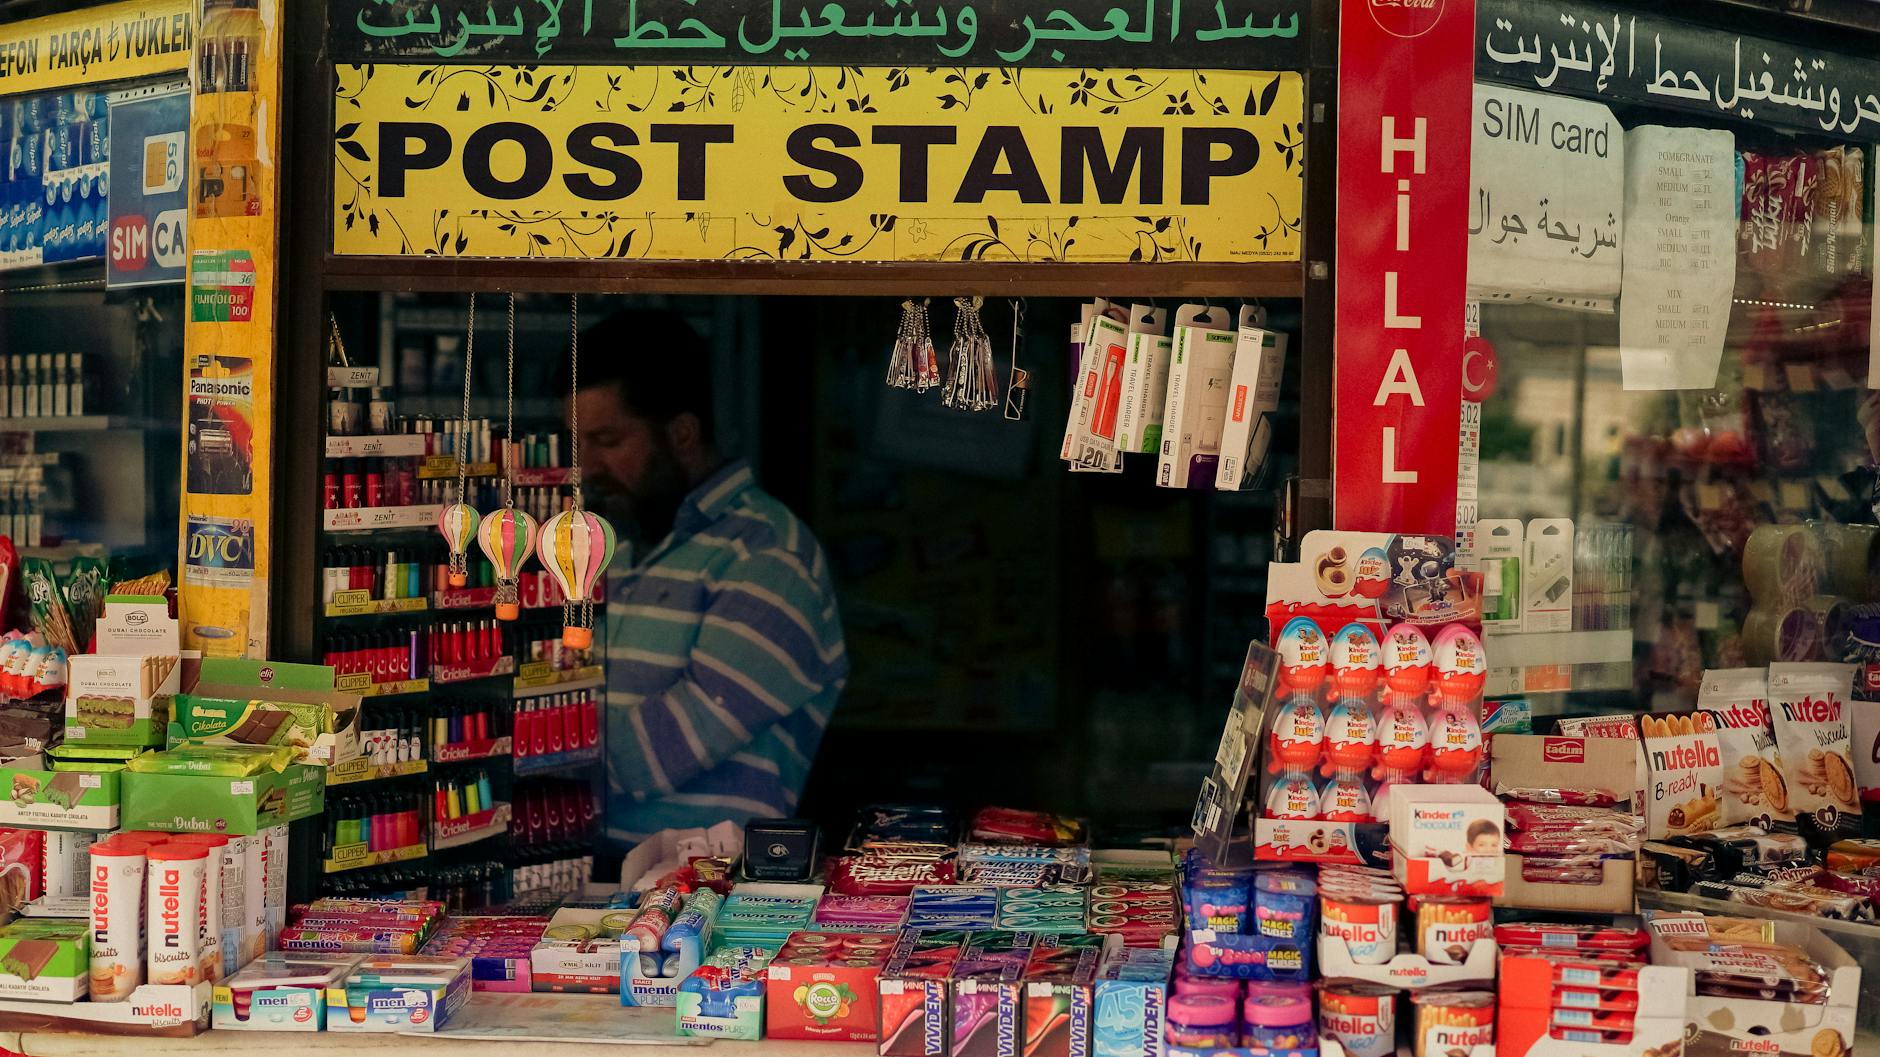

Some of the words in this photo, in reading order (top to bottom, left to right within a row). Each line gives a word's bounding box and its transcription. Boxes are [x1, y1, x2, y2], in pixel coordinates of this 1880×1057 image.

[49, 27, 102, 75] PARÇA
[1482, 98, 1540, 146] SIM
[1551, 121, 1609, 159] card
[166, 142, 177, 181] 5G
[377, 121, 734, 201] POST
[782, 123, 1261, 205] STAMP
[1658, 151, 1714, 164] POMEGRANATE
[1658, 167, 1684, 177] SMALL
[1656, 182, 1688, 193] MEDIUM
[1665, 213, 1690, 225] Orange
[1537, 198, 1617, 259] شريحة
[112, 223, 147, 261] SIM
[154, 220, 185, 256] CA
[232, 306, 248, 316] 100
[1466, 303, 1478, 323] 02
[191, 379, 250, 396] Panasonic
[1129, 369, 1137, 396] TRAVEL
[1123, 395, 1134, 428] CHARGER
[1460, 404, 1478, 424] 502
[1456, 505, 1475, 524] 502
[189, 533, 244, 562] DVC
[337, 593, 366, 603] CLIPPER
[260, 669, 273, 679] elit
[441, 669, 471, 679] Cricket
[340, 677, 369, 688] CLIPPER
[191, 718, 227, 733] Çikolata
[1652, 740, 1721, 772] nutella
[337, 761, 366, 772] CLIPPER
[1655, 771, 1699, 801] B-ready
[1414, 808, 1450, 820] Kinder
[174, 816, 212, 830] Dubai
[441, 823, 470, 836] Cricket
[337, 847, 366, 858] CLIPPER
[92, 866, 109, 943] nutella
[159, 869, 180, 948] nutella
[1207, 916, 1238, 926] MAGIC
[1261, 919, 1293, 930] MAGIC
[1652, 918, 1706, 936] hanuta
[1322, 922, 1376, 942] nutella
[287, 939, 342, 950] mentos
[90, 948, 119, 958] scuits
[154, 951, 190, 964] biscuits
[1267, 951, 1301, 960] MAGIC
[1267, 958, 1301, 969] CUBES
[1389, 967, 1427, 977] nutella
[258, 996, 288, 1006] men
[640, 996, 664, 1005] PURE
[811, 993, 837, 1004] Rocco
[131, 1003, 182, 1018] nutella
[151, 1016, 182, 1028] biscuits
[682, 1022, 723, 1032] mentos
[1321, 1014, 1375, 1035] nutella
[1730, 1039, 1781, 1053] nutella
